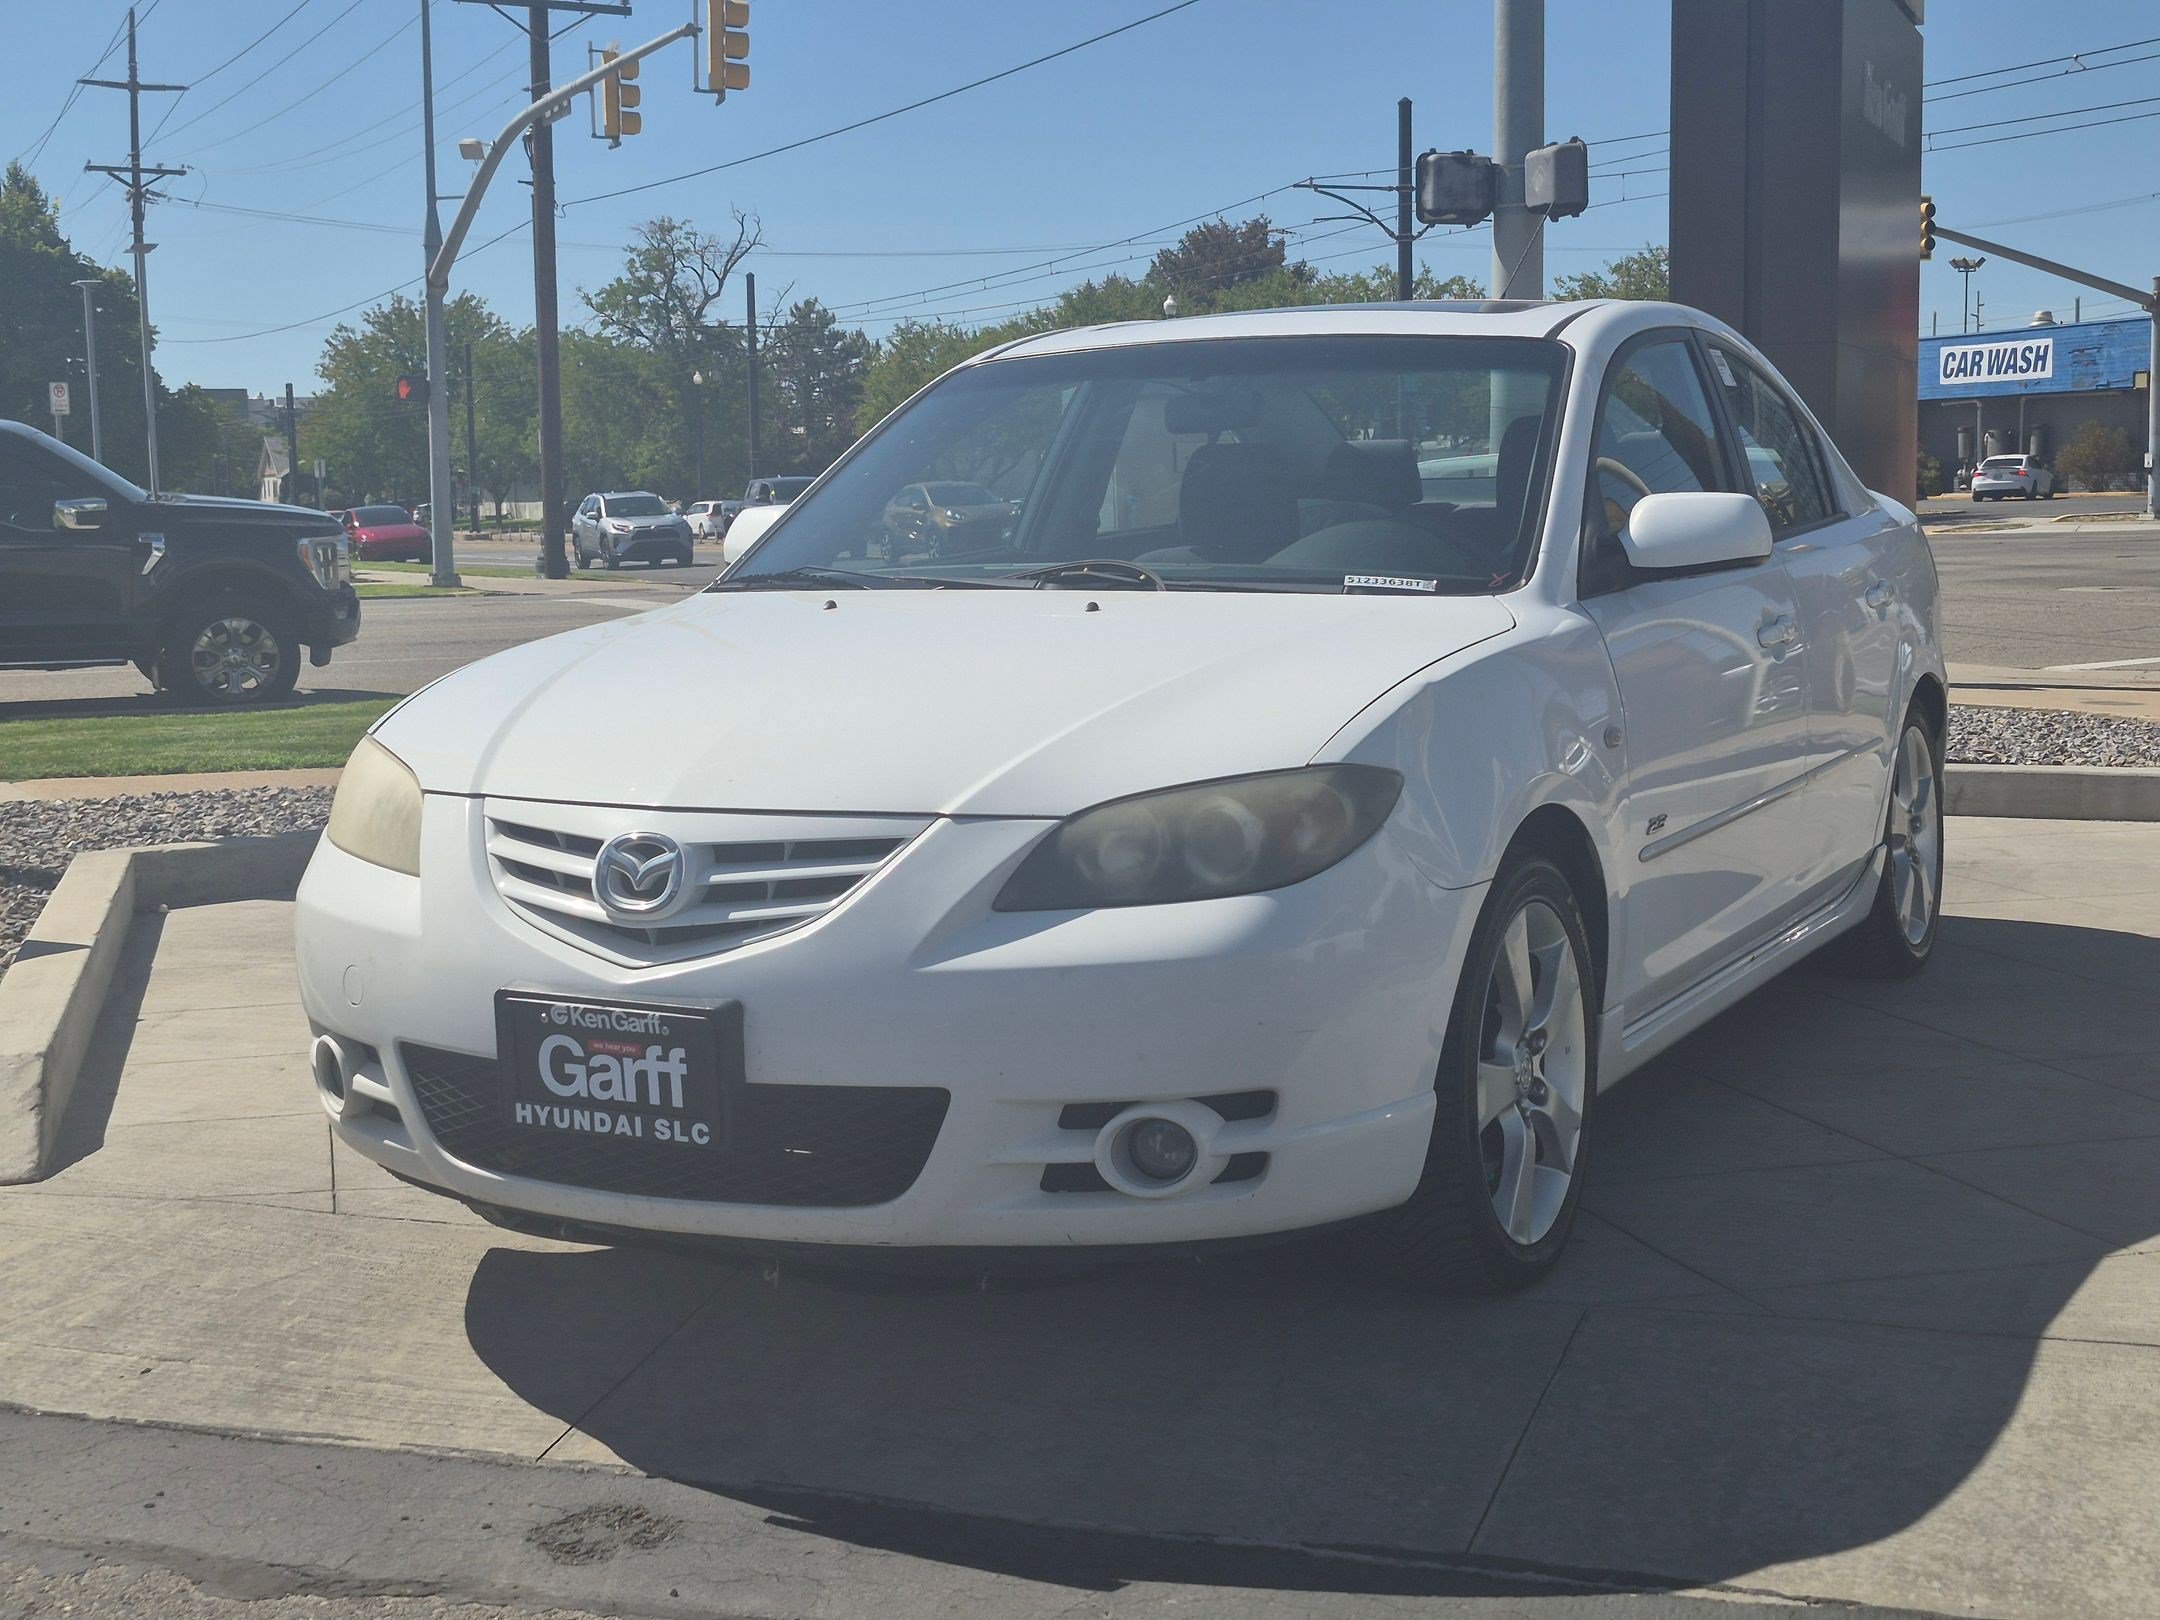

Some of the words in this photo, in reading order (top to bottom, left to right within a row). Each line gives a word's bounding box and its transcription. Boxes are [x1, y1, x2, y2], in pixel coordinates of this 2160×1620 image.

[1942, 351, 1984, 379] CAR
[1987, 344, 2050, 376] WASH
[538, 1034, 688, 1109] Garff
[515, 1102, 643, 1138] HYUNDAI
[654, 1118, 711, 1145] SLC
